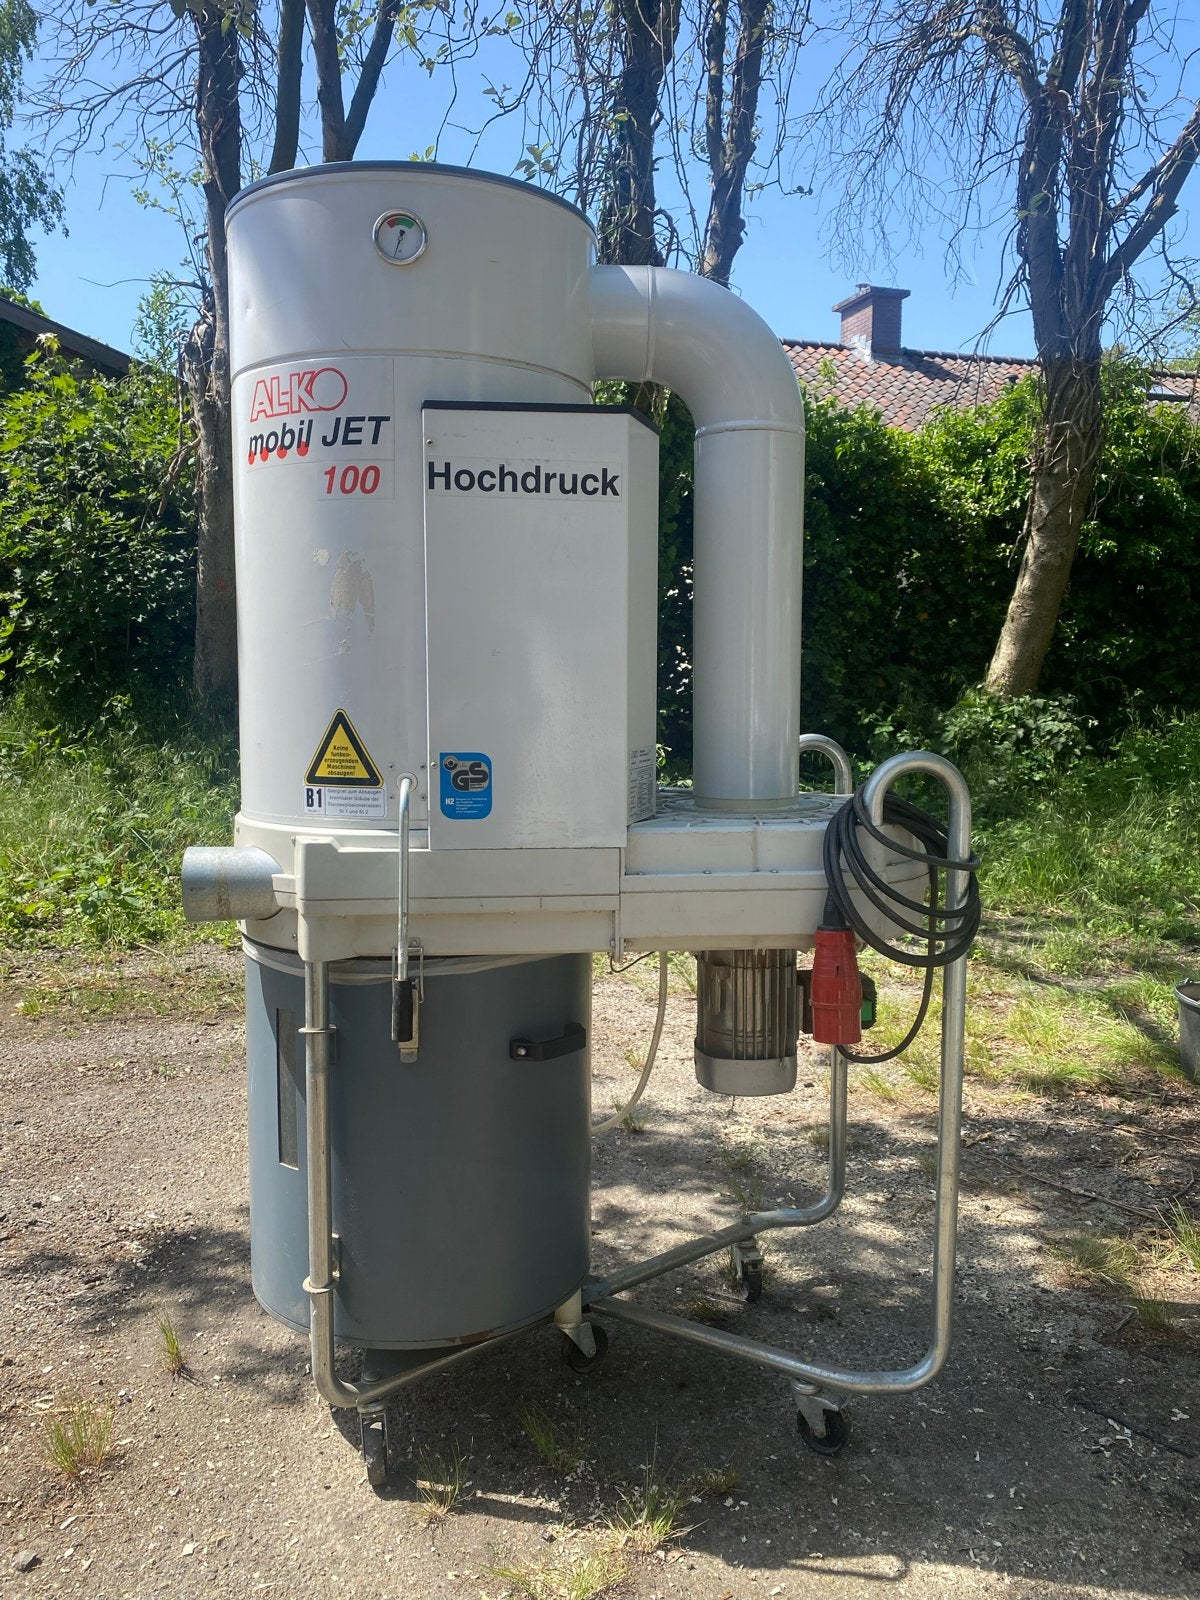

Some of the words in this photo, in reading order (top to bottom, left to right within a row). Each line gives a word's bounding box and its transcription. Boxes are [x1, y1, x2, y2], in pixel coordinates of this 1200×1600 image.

[249, 367, 348, 422] AL-KO
[249, 419, 313, 457] mobil
[321, 416, 390, 447] JET
[324, 465, 381, 495] 100
[428, 461, 620, 496] Hochdruck
[452, 761, 489, 791] GS
